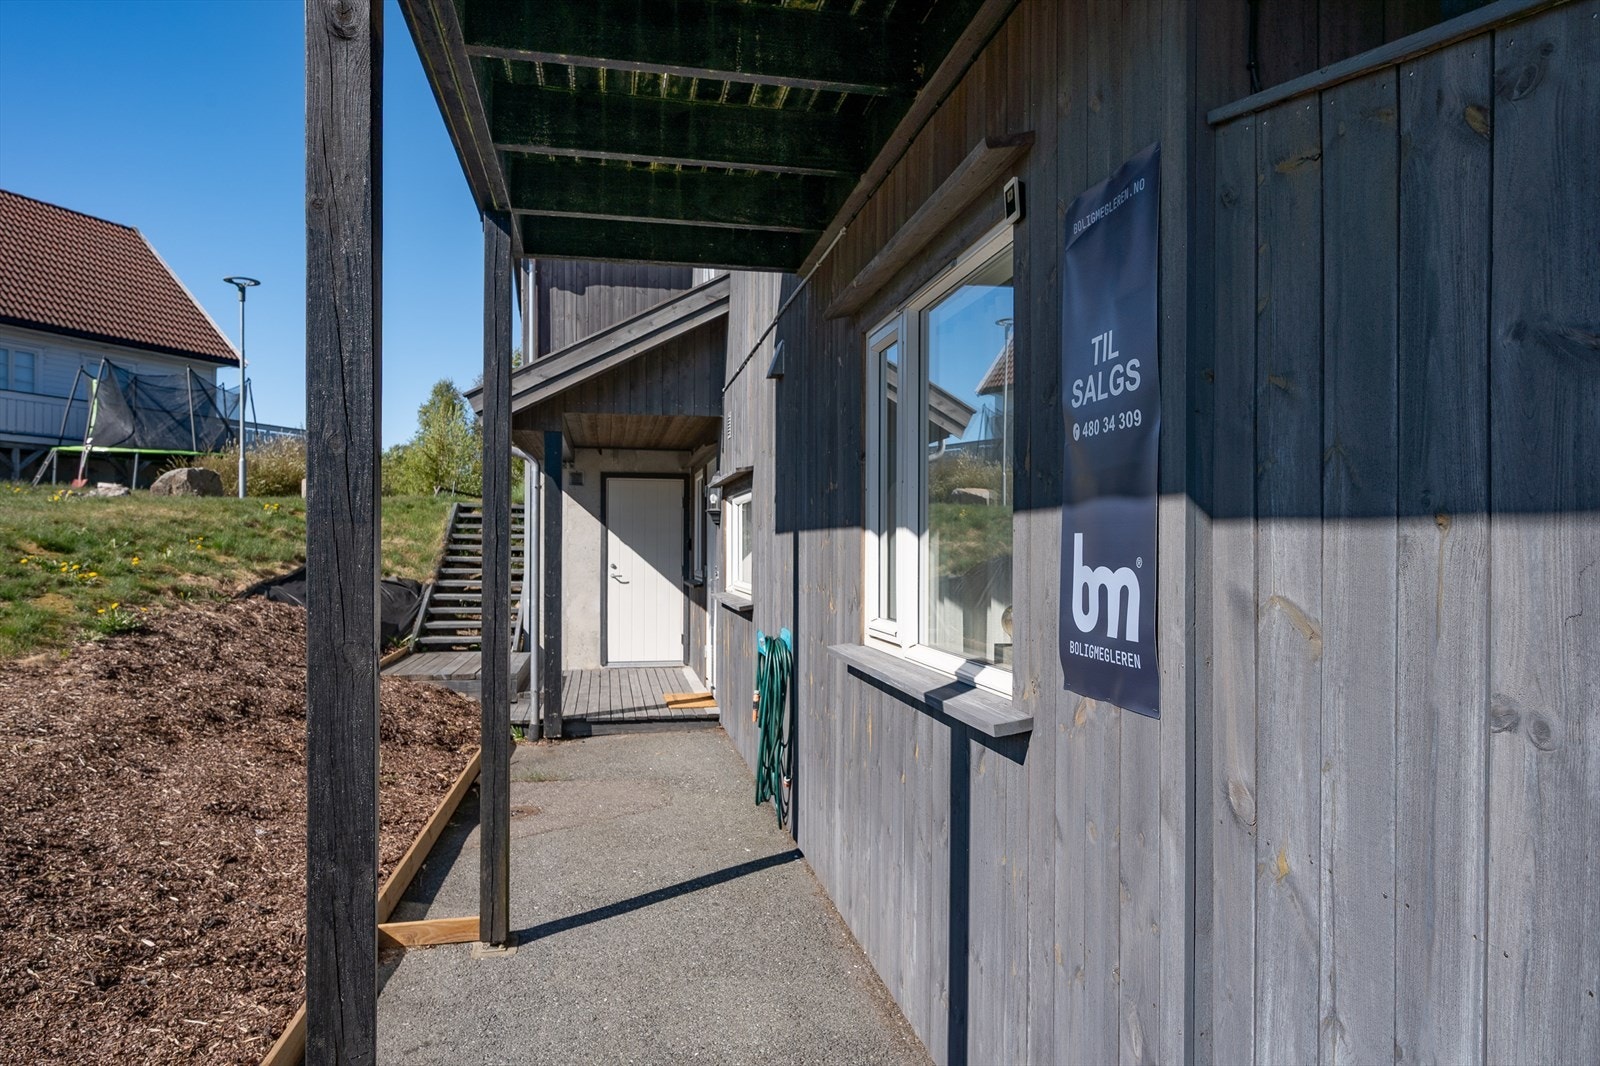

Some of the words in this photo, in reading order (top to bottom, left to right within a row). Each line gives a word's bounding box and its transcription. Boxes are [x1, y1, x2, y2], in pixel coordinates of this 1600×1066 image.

[1073, 178, 1145, 235] BOLIGMEGLEREN.NO
[1091, 330, 1119, 366] TIL
[1071, 358, 1141, 408] SALGS
[1082, 417, 1100, 438] 480
[1102, 414, 1116, 433] 34
[1118, 409, 1142, 429] 309
[1069, 640, 1141, 669] BOLIGMEGLEREN
